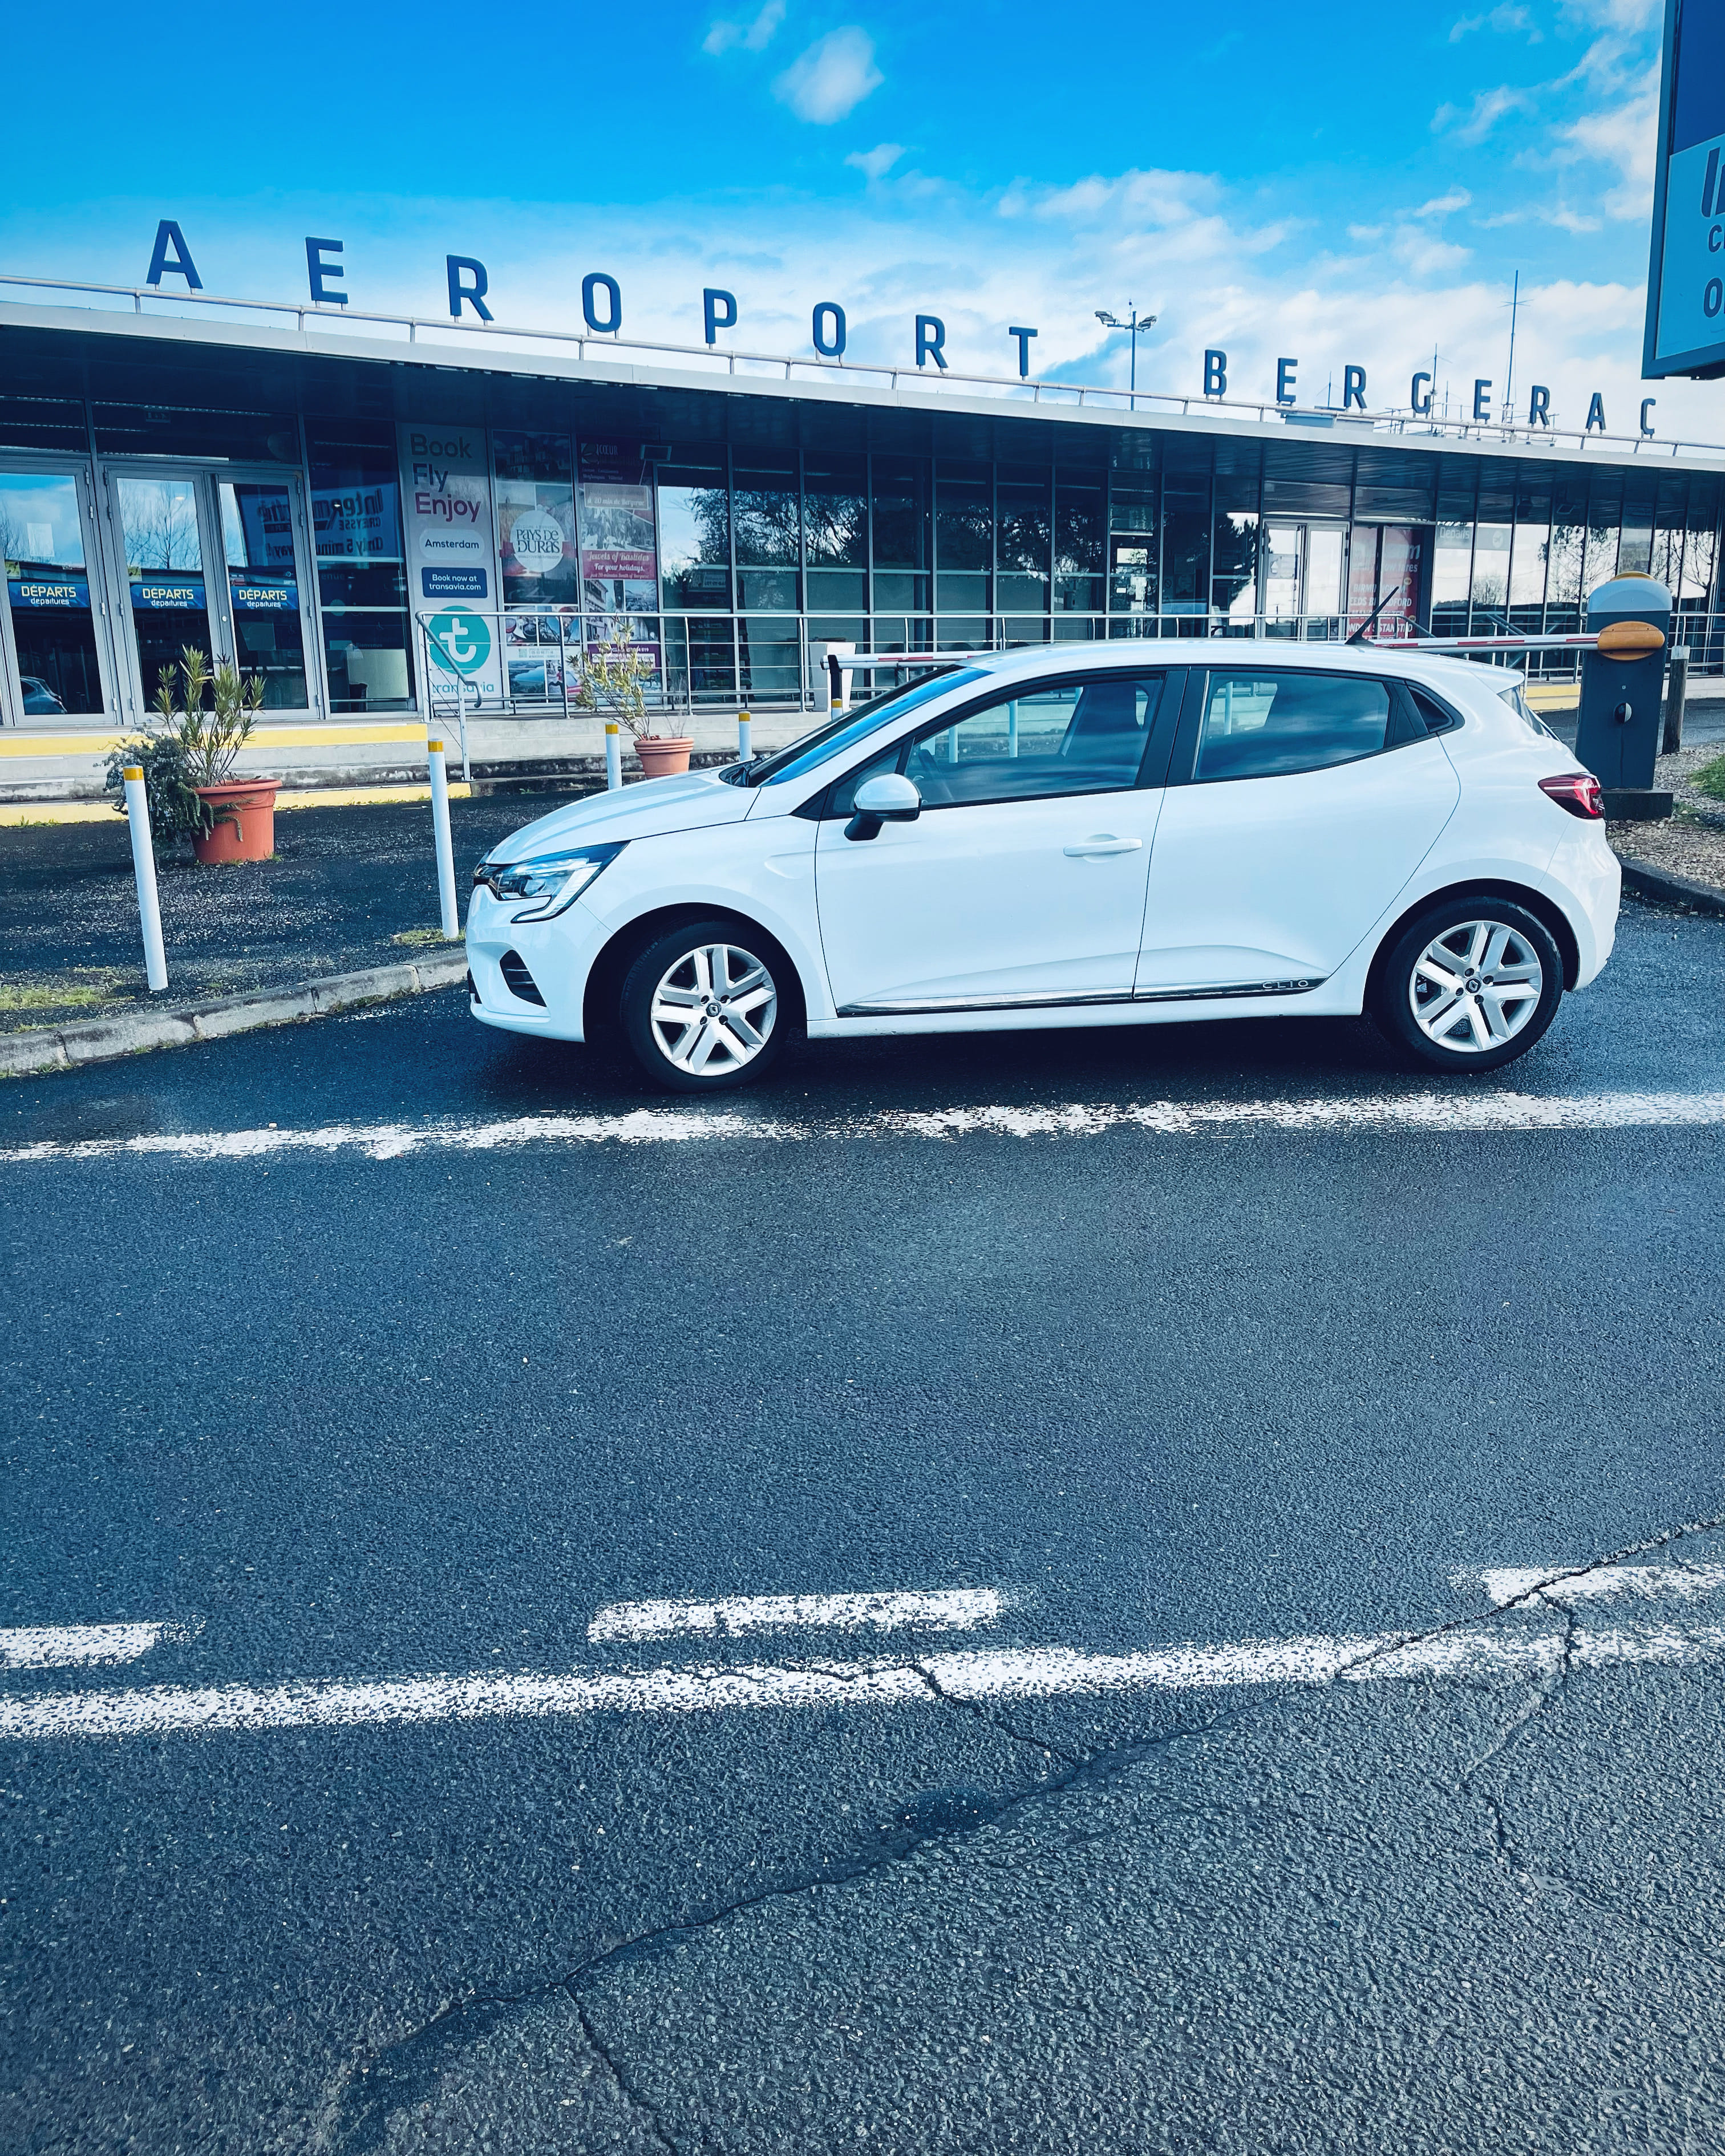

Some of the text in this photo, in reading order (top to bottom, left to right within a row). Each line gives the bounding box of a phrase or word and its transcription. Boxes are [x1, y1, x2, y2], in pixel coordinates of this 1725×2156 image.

[145, 218, 1657, 435] AEROPORT BERGERAC
[410, 433, 472, 458] Book
[413, 463, 448, 492] Fly
[415, 492, 481, 522] Enjoy
[425, 538, 480, 549] Amsterdam
[588, 551, 649, 563] Jewels of Bastides
[21, 584, 76, 598] DÉPARTS
[143, 586, 194, 599] DÉPARTS
[239, 589, 288, 601] DÉPARTS
[1350, 597, 1367, 606] EEDS
[1262, 980, 1309, 989] CLIO
